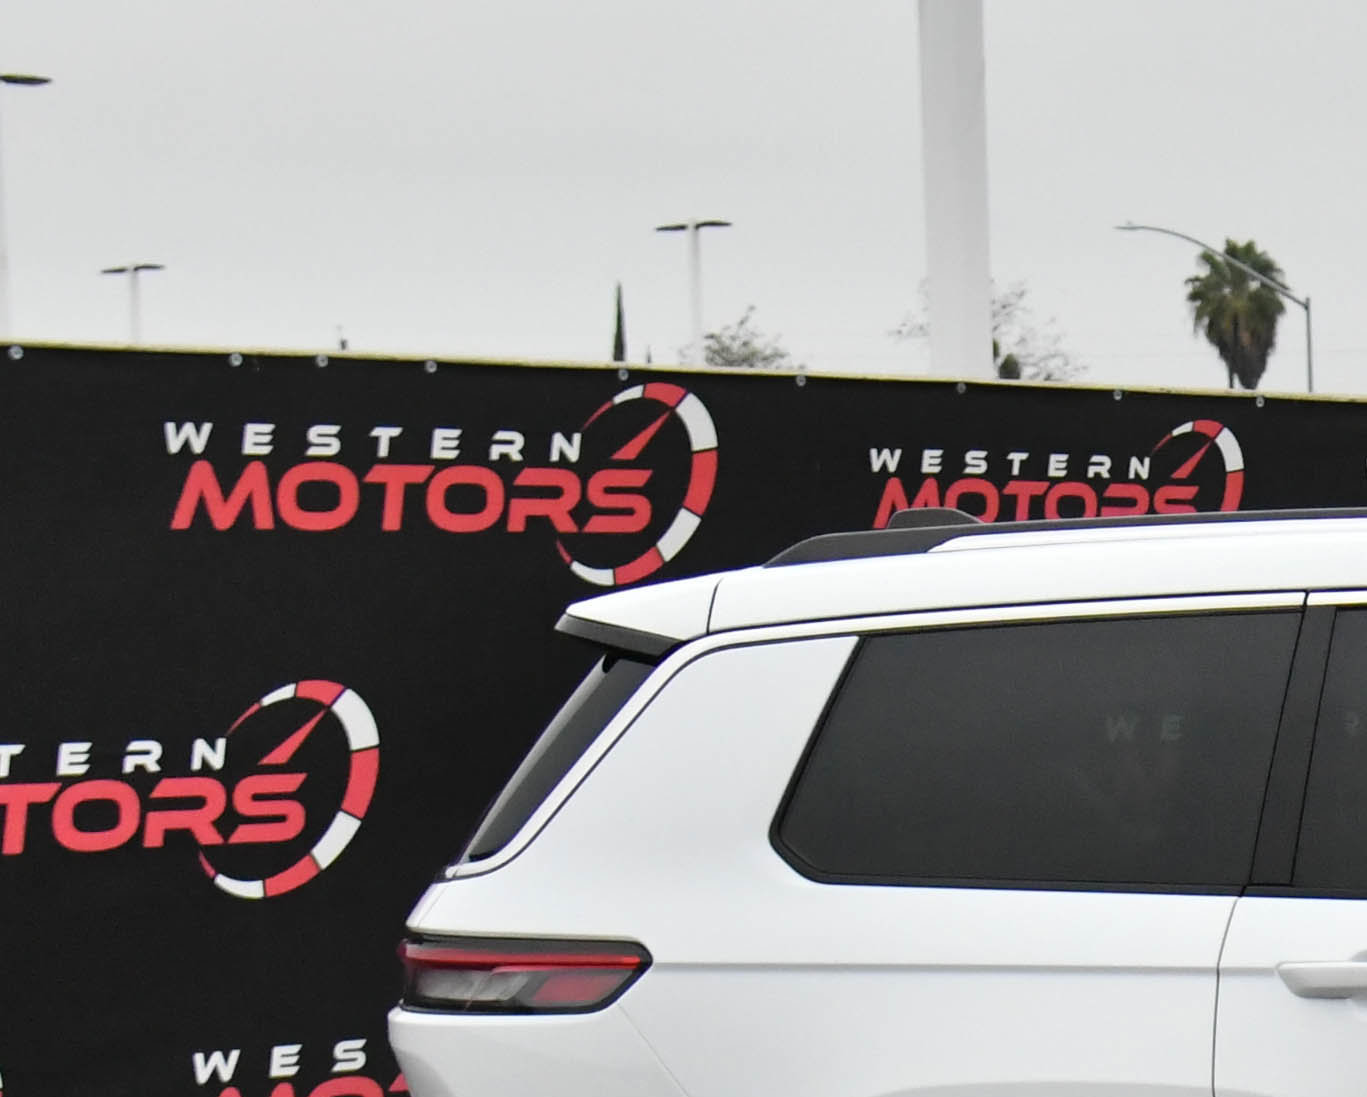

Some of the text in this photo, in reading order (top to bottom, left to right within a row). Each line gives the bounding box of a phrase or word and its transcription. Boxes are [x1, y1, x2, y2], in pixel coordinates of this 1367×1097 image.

[164, 421, 582, 463] WESTERN
[869, 448, 1151, 480] WESTERN
[170, 459, 654, 533] MOTORS
